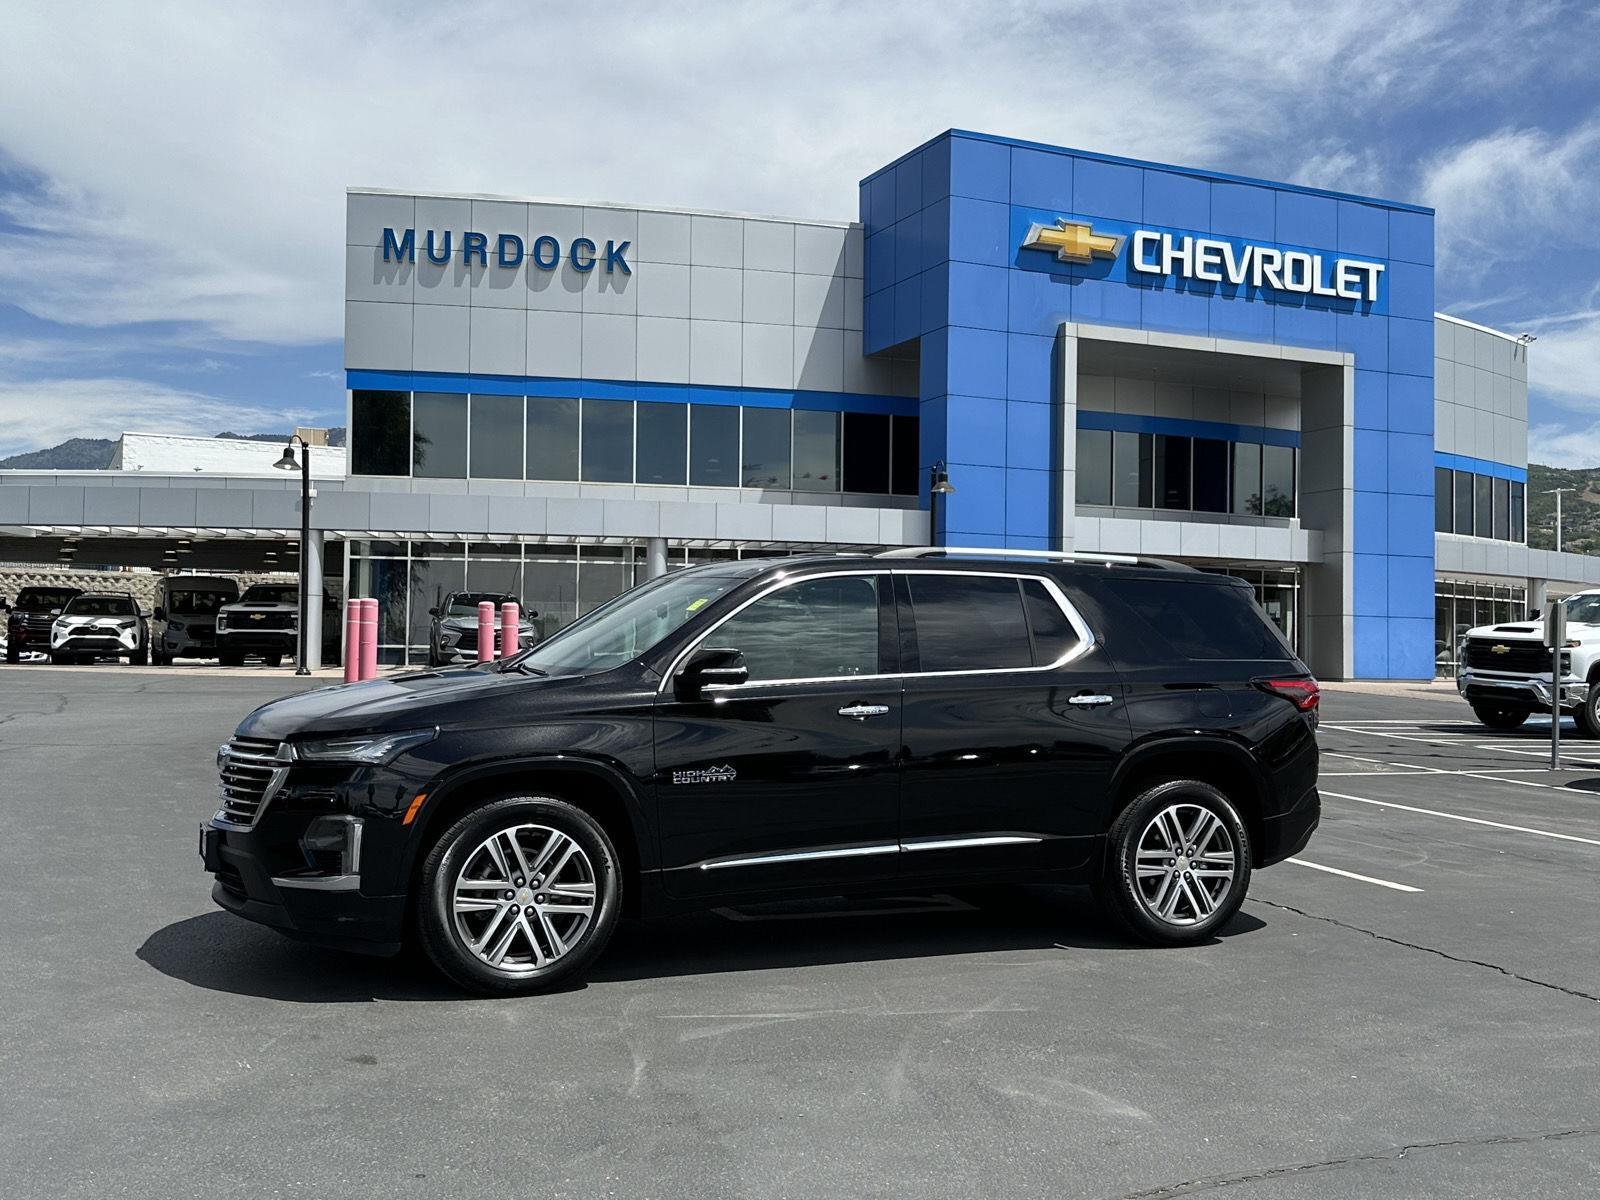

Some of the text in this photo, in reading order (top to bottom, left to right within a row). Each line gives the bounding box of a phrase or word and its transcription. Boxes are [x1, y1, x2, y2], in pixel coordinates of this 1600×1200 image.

[383, 227, 632, 275] MURDOCK
[1132, 230, 1385, 301] CHEVROLET
[673, 775, 737, 784] COUNTRY
